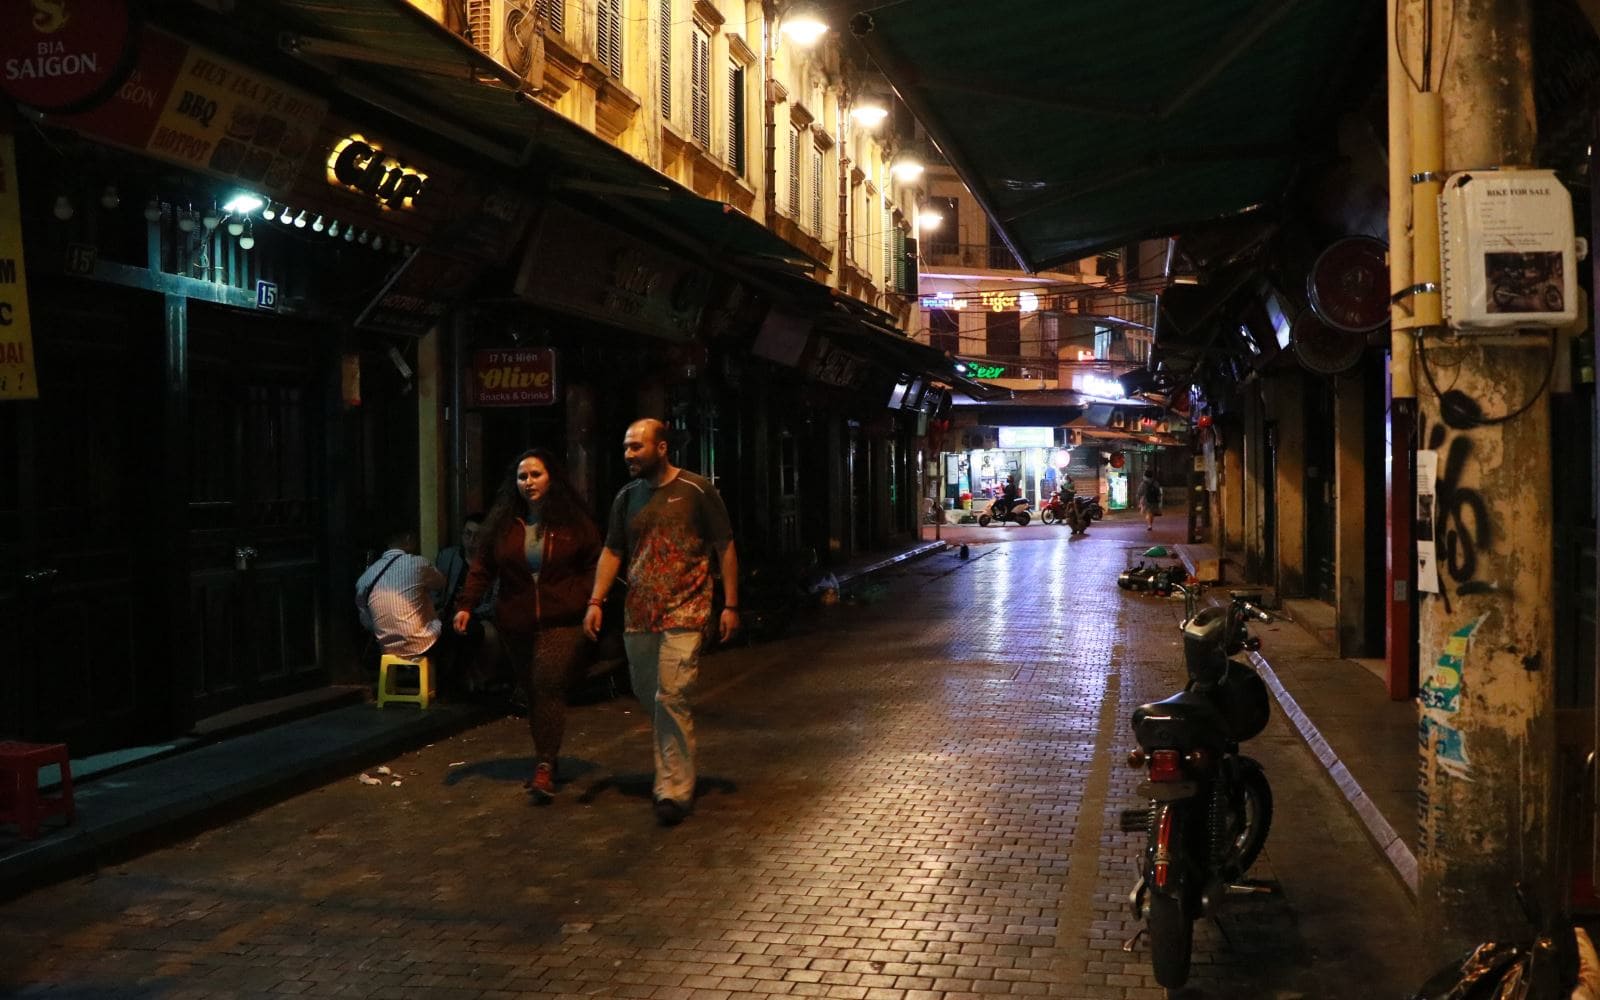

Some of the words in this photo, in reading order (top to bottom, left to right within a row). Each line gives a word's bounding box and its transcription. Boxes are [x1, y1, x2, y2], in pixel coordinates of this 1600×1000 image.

[37, 41, 64, 55] BIA
[5, 52, 97, 80] SAIGON
[176, 90, 218, 128] BBQ
[1486, 188, 1507, 197] BIKE
[1510, 187, 1528, 196] FOR
[1529, 187, 1551, 196] SALE
[261, 285, 277, 305] 15
[980, 291, 1018, 313] Tiger
[478, 366, 550, 390] Olive
[520, 391, 550, 401] Drinks
